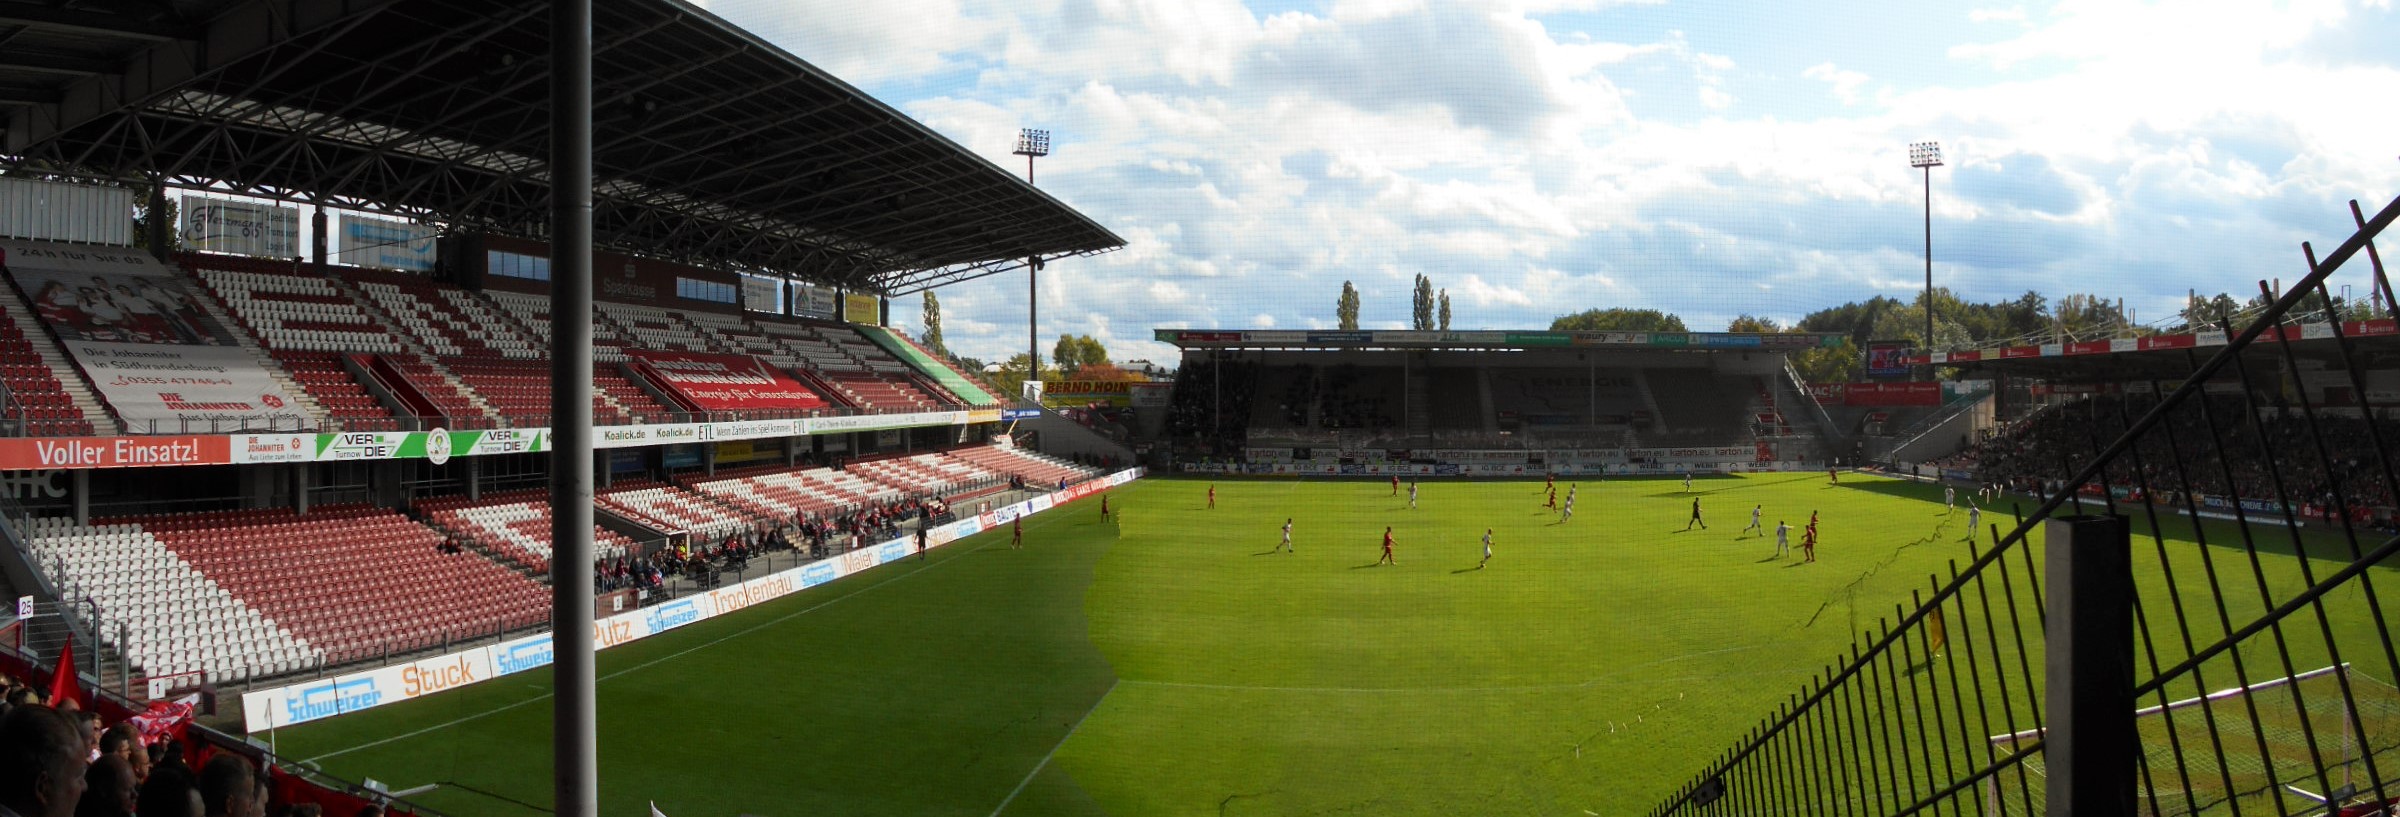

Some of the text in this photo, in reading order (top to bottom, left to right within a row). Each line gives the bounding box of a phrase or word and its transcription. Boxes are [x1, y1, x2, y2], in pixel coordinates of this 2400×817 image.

[266, 211, 298, 225] Spedition
[266, 227, 298, 239] Transport
[604, 277, 656, 300] Sparkasse
[83, 348, 182, 358] Die Johanniter
[93, 359, 108, 368] in
[1046, 381, 1129, 393] BERND HOIN
[158, 393, 184, 402] DIE
[684, 387, 731, 401] Energie
[165, 402, 253, 410] JOHANNITER
[489, 431, 511, 441] VER
[604, 428, 694, 442] Koalick.de Koalick.de
[698, 424, 714, 440] ETL
[717, 427, 731, 437] Wenn
[732, 425, 750, 436] Zahlen
[758, 424, 770, 435] Spiel
[793, 420, 806, 434] ETL
[345, 434, 374, 445] VER
[36, 438, 198, 465] Voller Einsatz!
[248, 444, 284, 452] JOHANNITER
[335, 446, 386, 458] Turnow DIE
[480, 441, 520, 453] Turnow DIE
[1670, 448, 1710, 457] karton.eu
[1715, 447, 1754, 456] karton.eu
[287, 452, 302, 460] Leben
[1577, 449, 1618, 459] karton.eu
[996, 505, 1018, 523] BAUTEC
[842, 550, 873, 574] Maler
[709, 575, 793, 615] Trockenbau
[21, 601, 32, 615] 25
[647, 600, 699, 634] Schweizer
[497, 637, 553, 675] Schweiz
[402, 655, 474, 697] Stuck
[155, 682, 160, 694] 1
[287, 677, 382, 723] Schweizer
